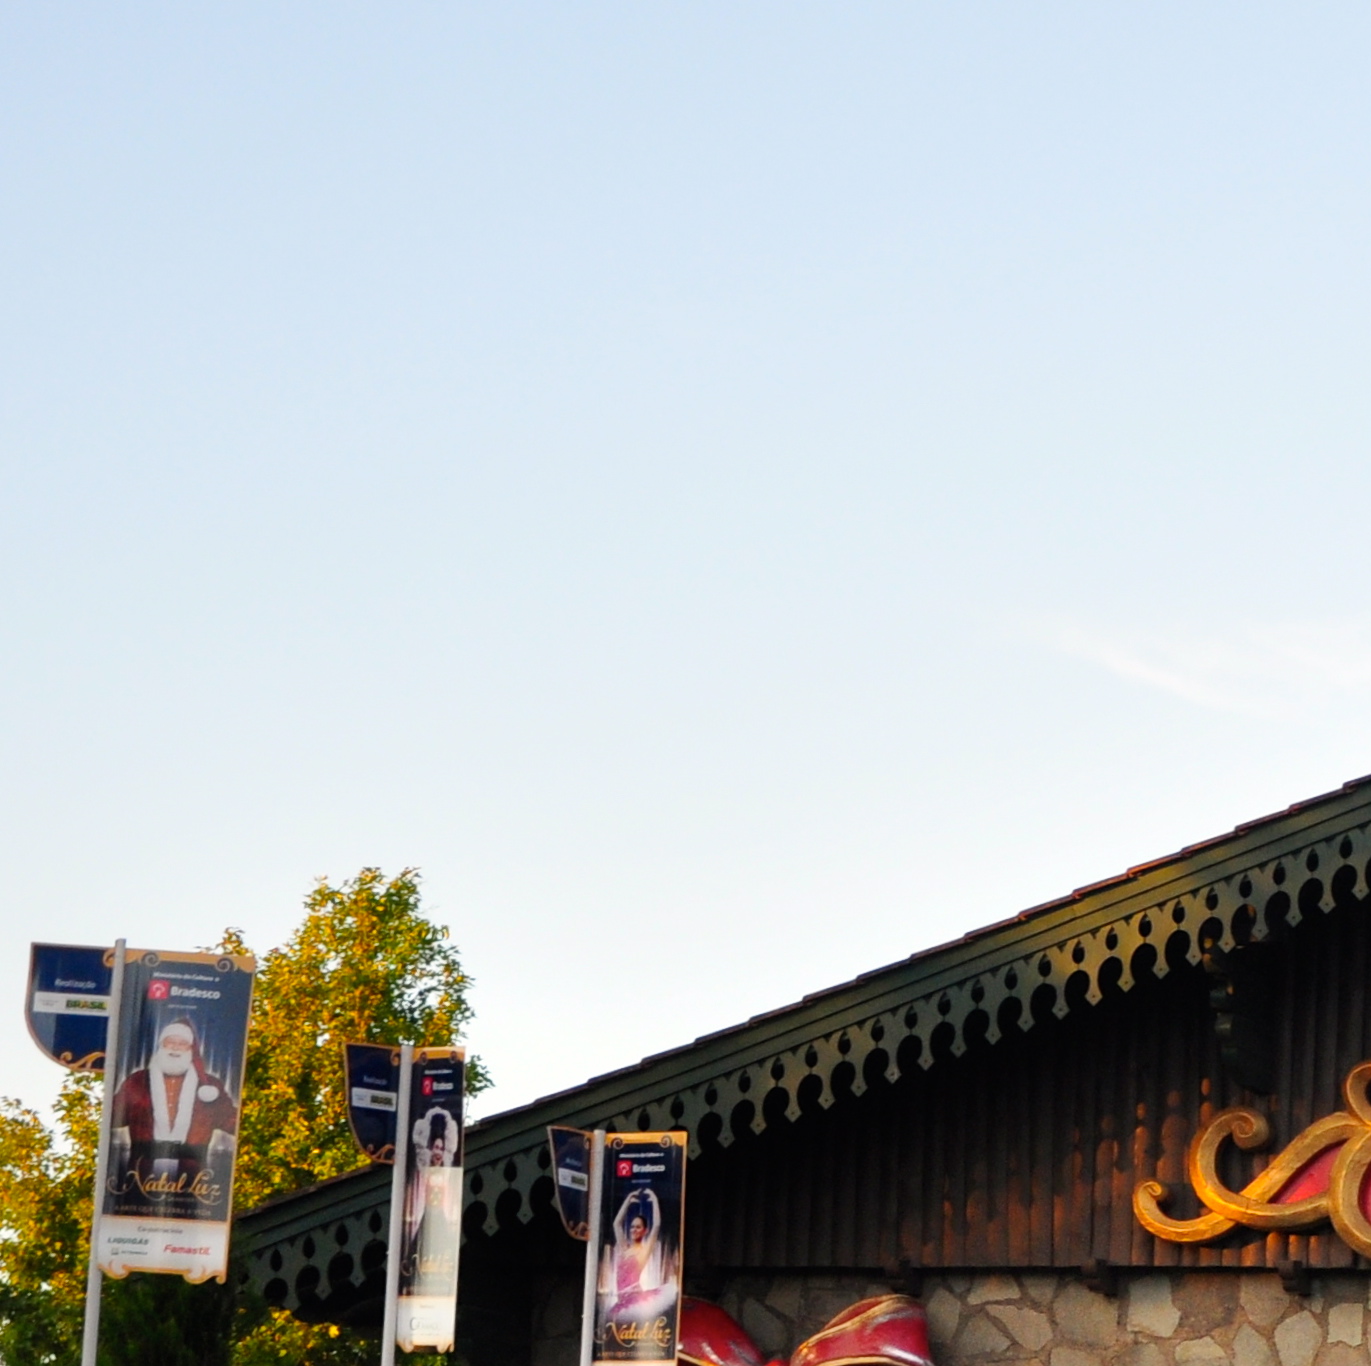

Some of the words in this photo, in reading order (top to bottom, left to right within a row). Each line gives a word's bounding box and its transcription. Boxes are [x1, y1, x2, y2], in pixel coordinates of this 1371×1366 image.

[171, 986, 221, 1000] Bradesco
[106, 1155, 188, 1201] Natal
[187, 1168, 222, 1206] Luz
[594, 1313, 649, 1348] Natal
